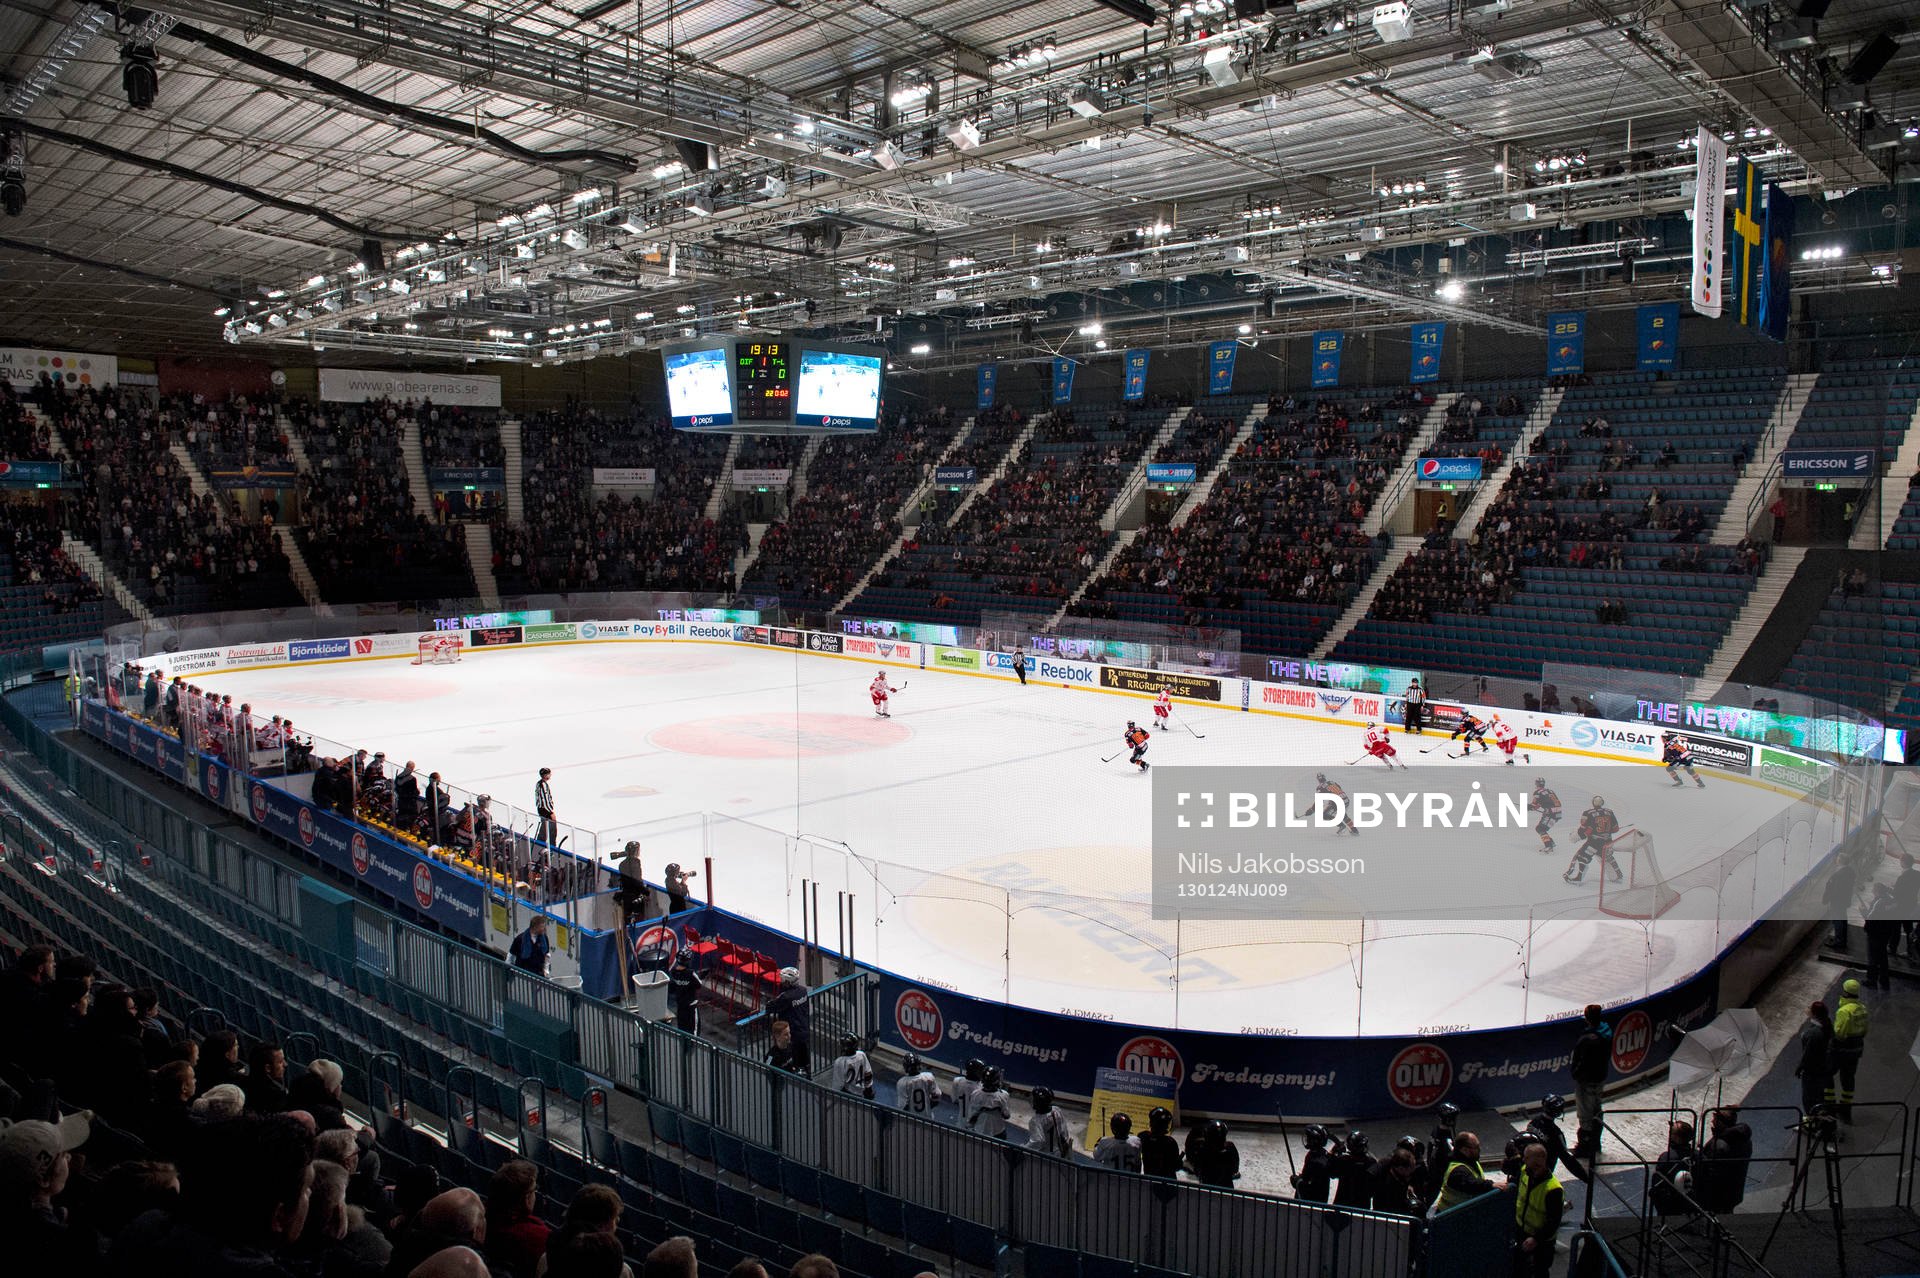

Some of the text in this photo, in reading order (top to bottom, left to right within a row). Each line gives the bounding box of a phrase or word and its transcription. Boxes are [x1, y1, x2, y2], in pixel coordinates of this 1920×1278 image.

[1555, 323, 1578, 334] 25
[1653, 318, 1664, 328] 2
[1421, 333, 1437, 343] 11
[1319, 341, 1337, 350] 22
[1216, 350, 1232, 359] 27
[1131, 359, 1144, 367] 12
[349, 380, 478, 395] www.globearenas.se
[698, 416, 713, 425] pepsi
[831, 417, 851, 426] pepsi
[1441, 463, 1472, 475] pepsi
[1788, 458, 1847, 470] ERICSSON
[937, 471, 965, 479] ERICSSON
[658, 609, 713, 622] THE NEW
[434, 614, 493, 631] THE NEW
[842, 619, 861, 633] THE
[526, 631, 568, 640] CASHBUDDY
[633, 624, 685, 637] PayByBill
[690, 626, 731, 638] Reebok
[822, 636, 838, 644] HAGA
[1032, 636, 1055, 651] THE
[291, 642, 348, 658] Björnkläder
[207, 660, 217, 668] AB
[1041, 663, 1093, 682] Reebok
[1269, 660, 1343, 684] THE NEW
[1263, 687, 1316, 708] STORFORMATS
[1637, 700, 1739, 732] THE NEW
[1526, 728, 1550, 738] pwc
[1600, 729, 1655, 746] VIASAT
[415, 875, 480, 918] OLW Fredagsmys!
[901, 1005, 1068, 1062] OLW Fredagsmys!
[1616, 1027, 1647, 1056] OLW
[1457, 1051, 1576, 1084] Fredagsmys!
[846, 1065, 864, 1085] 24
[1190, 1061, 1337, 1090] Fredagsmys!
[1396, 1063, 1445, 1088] OLW
[913, 1089, 926, 1112] 9
